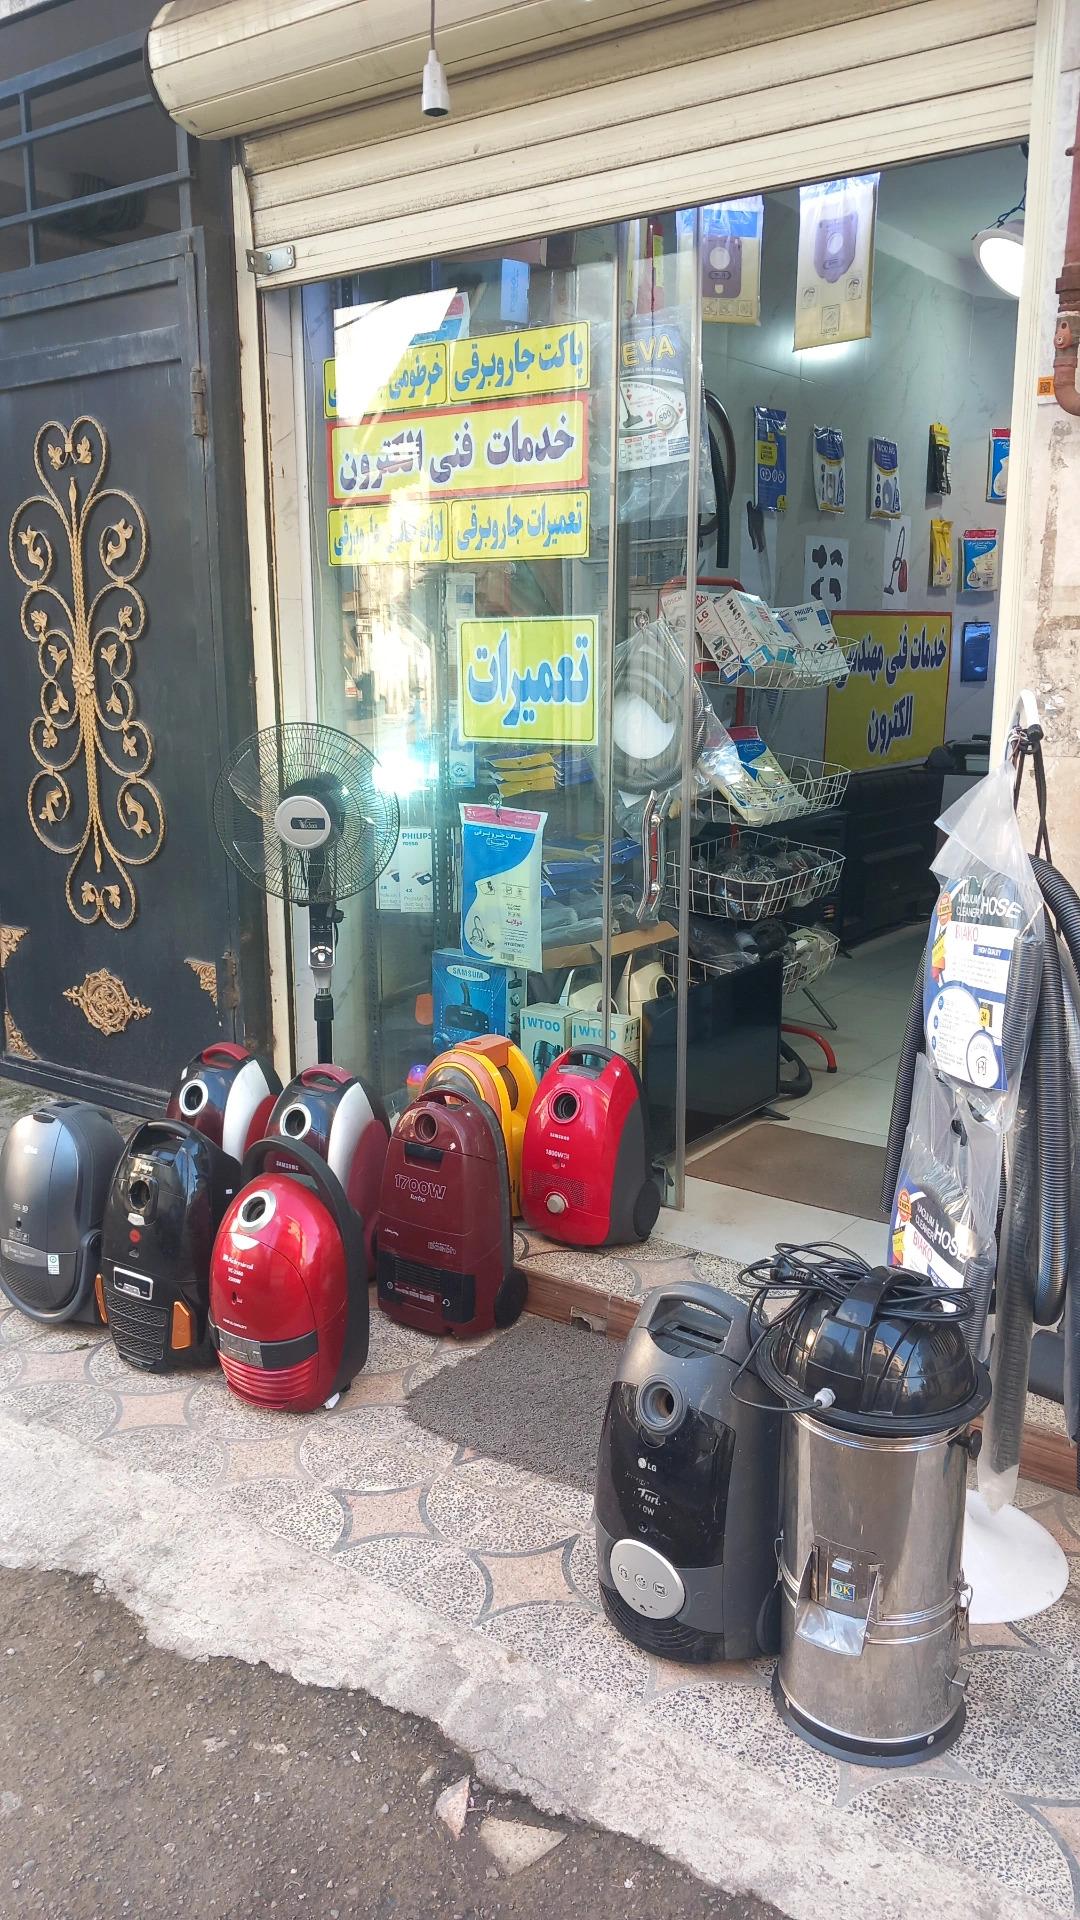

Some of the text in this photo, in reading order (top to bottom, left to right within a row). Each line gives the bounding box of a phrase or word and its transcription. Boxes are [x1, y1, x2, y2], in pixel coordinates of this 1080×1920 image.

[454, 330, 583, 392] پاکت جاروبرقی
[621, 334, 676, 367] EVA
[388, 351, 443, 400] خرطومی
[659, 409, 673, 422] 500
[430, 422, 474, 483] فنی
[487, 414, 575, 465] خدمات
[457, 503, 524, 551] جاروبرقی
[527, 501, 583, 548] تعمیرات
[696, 610, 709, 624] LG
[794, 606, 814, 617] PHILIPS
[886, 624, 908, 685] فنی
[910, 626, 947, 669] خدمات
[468, 631, 589, 727] تعمیرات
[867, 695, 914, 755] الکترون
[980, 896, 1024, 919] HOSE
[395, 1173, 447, 1200] 1700W
[834, 1583, 849, 1596] OK
